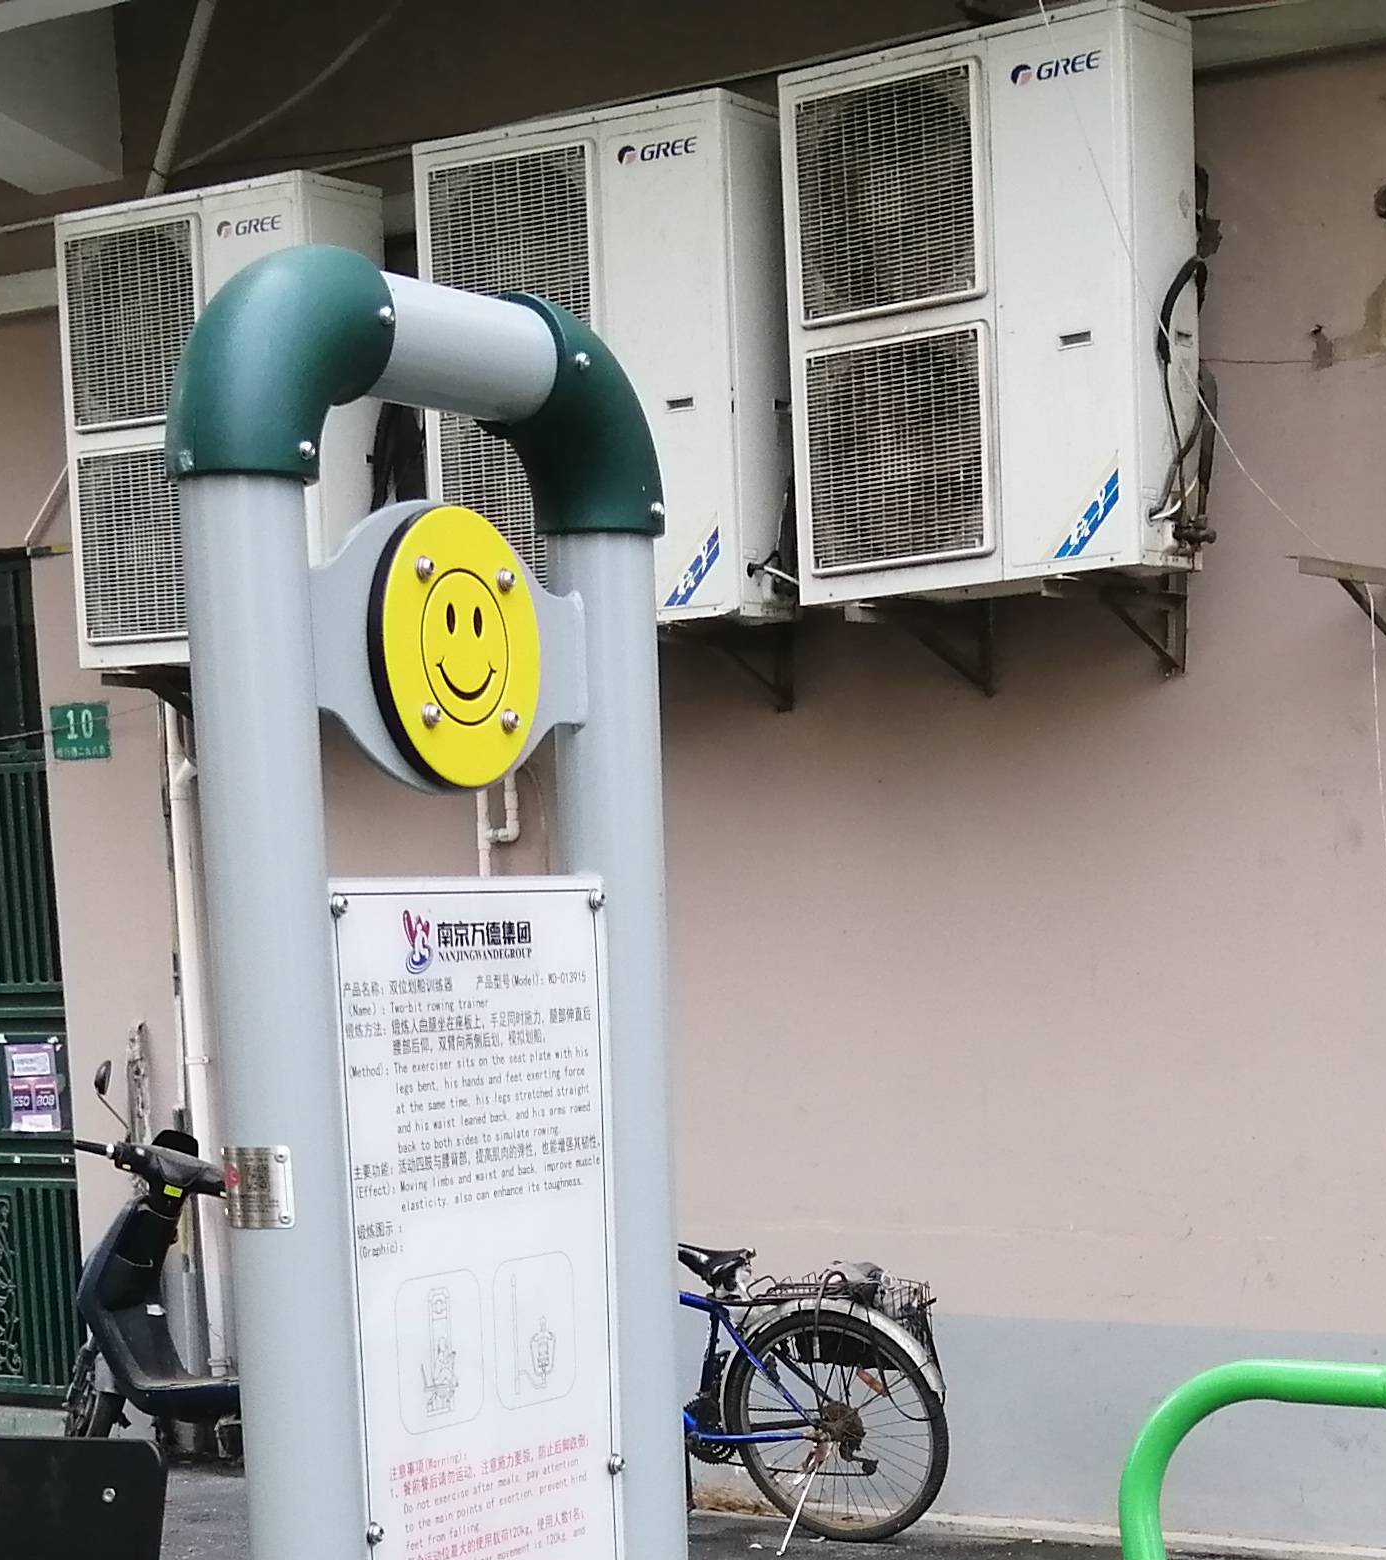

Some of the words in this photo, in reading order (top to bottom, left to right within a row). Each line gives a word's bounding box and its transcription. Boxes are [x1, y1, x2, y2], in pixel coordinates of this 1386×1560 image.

[1036, 49, 1102, 81] GREE
[640, 136, 698, 162] GREE
[235, 214, 282, 236] GREE
[66, 709, 94, 740] 10
[437, 921, 531, 947] 南京万德集团
[438, 948, 531, 962] NANJINGWANDEGROUP
[390, 1001, 422, 1013] Two-bit
[427, 1001, 454, 1012] rowing
[458, 997, 488, 1009] trainer
[393, 1061, 407, 1073] The
[412, 1059, 451, 1072] exerciser
[457, 1056, 474, 1069] sits
[478, 1057, 488, 1067] on
[491, 1054, 504, 1065] the
[509, 1052, 526, 1063] seat
[529, 1050, 551, 1063] plate
[555, 1047, 572, 1059] with
[575, 1046, 588, 1057] his
[395, 1082, 413, 1095] legs
[444, 1077, 458, 1089] his
[461, 1074, 484, 1087] hands
[488, 1073, 501, 1084] and
[506, 1071, 522, 1082] feet
[526, 1067, 560, 1081] exerting
[564, 1065, 585, 1077] force
[396, 1103, 405, 1114] at
[409, 1101, 423, 1112] the
[428, 1100, 445, 1110] same
[475, 1094, 489, 1105] his
[494, 1092, 511, 1104] legs
[515, 1086, 553, 1101] stretched
[556, 1083, 589, 1097] straight
[397, 1120, 411, 1134] and
[415, 1120, 429, 1131] his
[433, 1118, 455, 1129] waist
[460, 1112, 486, 1126] leaned
[515, 1107, 529, 1120] and
[532, 1106, 545, 1117] his
[549, 1106, 566, 1116] arms
[570, 1100, 590, 1113] rowed
[397, 1140, 416, 1154] back
[420, 1140, 430, 1151] to
[433, 1136, 452, 1149] both
[456, 1134, 478, 1146] sides
[482, 1133, 491, 1143] to
[495, 1128, 529, 1141] simulate
[400, 1180, 427, 1192] Moving
[432, 1175, 454, 1187] limbs
[458, 1171, 471, 1184] and
[475, 1169, 497, 1181] waist
[501, 1165, 514, 1178] and
[544, 1160, 572, 1172] improve
[575, 1154, 600, 1167] muscle
[454, 1192, 472, 1204] also
[476, 1191, 490, 1200] can
[493, 1186, 523, 1198] enhance
[528, 1182, 540, 1192] its
[403, 1502, 413, 1514] Do
[416, 1498, 430, 1509] not
[434, 1489, 469, 1505] exercise
[473, 1482, 493, 1494] after
[526, 1470, 538, 1481] pay
[542, 1458, 578, 1475] attention
[404, 1523, 414, 1533] to
[418, 1518, 431, 1529] the
[435, 1512, 453, 1524] main
[456, 1503, 482, 1519] points
[486, 1496, 495, 1509] of
[539, 1478, 567, 1496] prevent
[570, 1471, 587, 1484] hind
[406, 1538, 423, 1551] feet
[427, 1533, 446, 1544] from
[497, 1543, 529, 1560] movement
[534, 1540, 542, 1549] is
[573, 1525, 585, 1537] and
